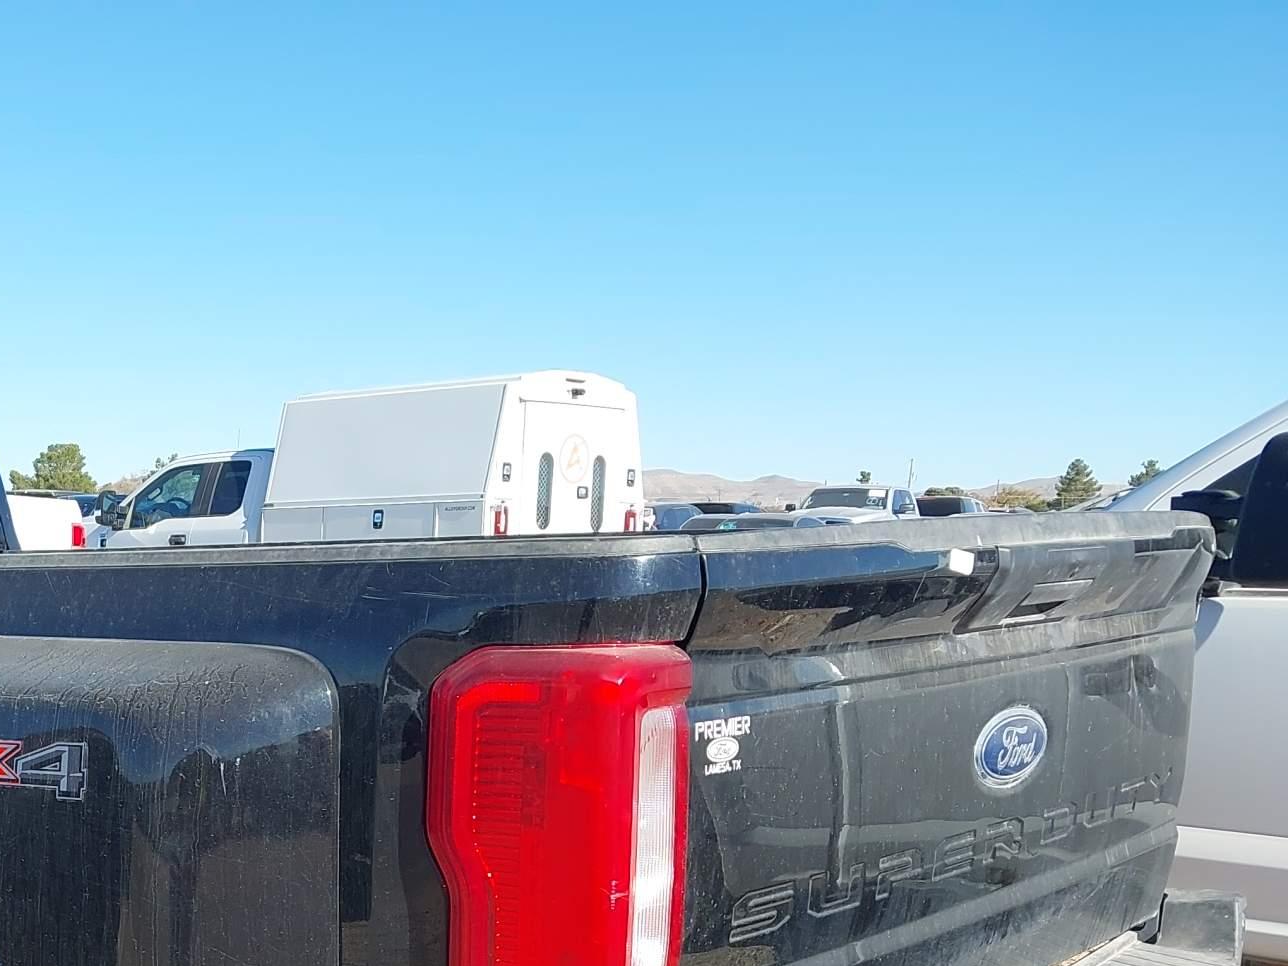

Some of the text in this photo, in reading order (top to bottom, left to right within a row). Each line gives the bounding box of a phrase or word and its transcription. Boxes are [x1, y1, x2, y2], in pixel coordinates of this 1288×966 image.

[695, 715, 751, 742] PREMIER
[728, 766, 1174, 944] SUPER DUTY
